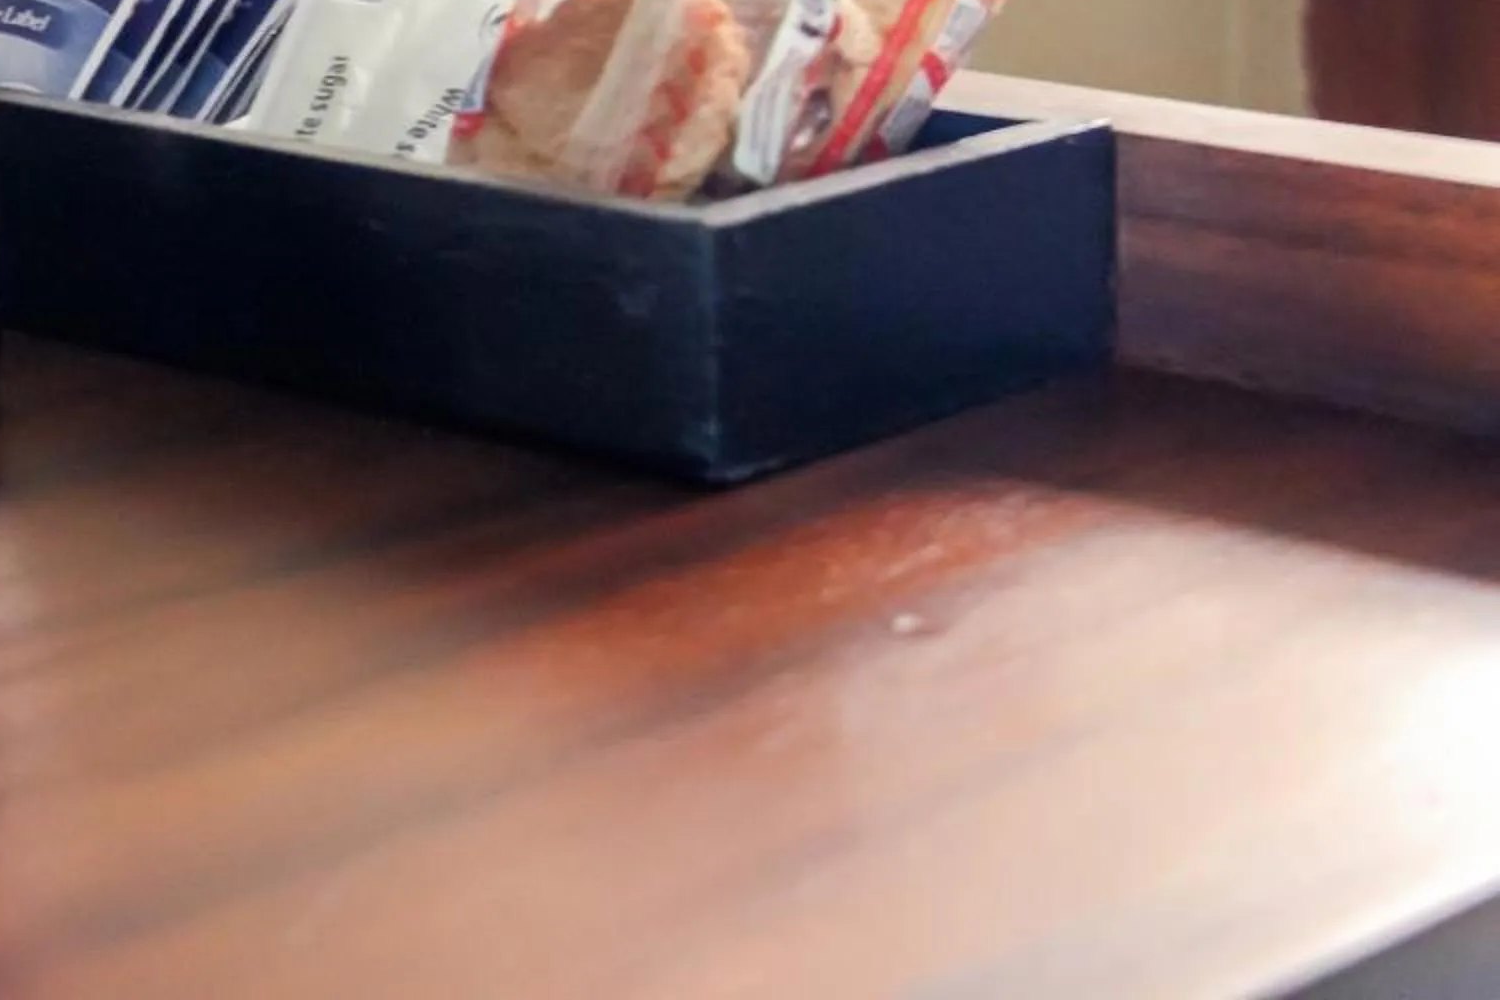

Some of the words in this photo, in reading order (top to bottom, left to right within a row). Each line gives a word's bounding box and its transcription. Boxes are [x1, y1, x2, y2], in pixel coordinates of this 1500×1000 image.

[3, 5, 52, 32] Label
[310, 56, 349, 112] sugar
[406, 87, 466, 139] White
